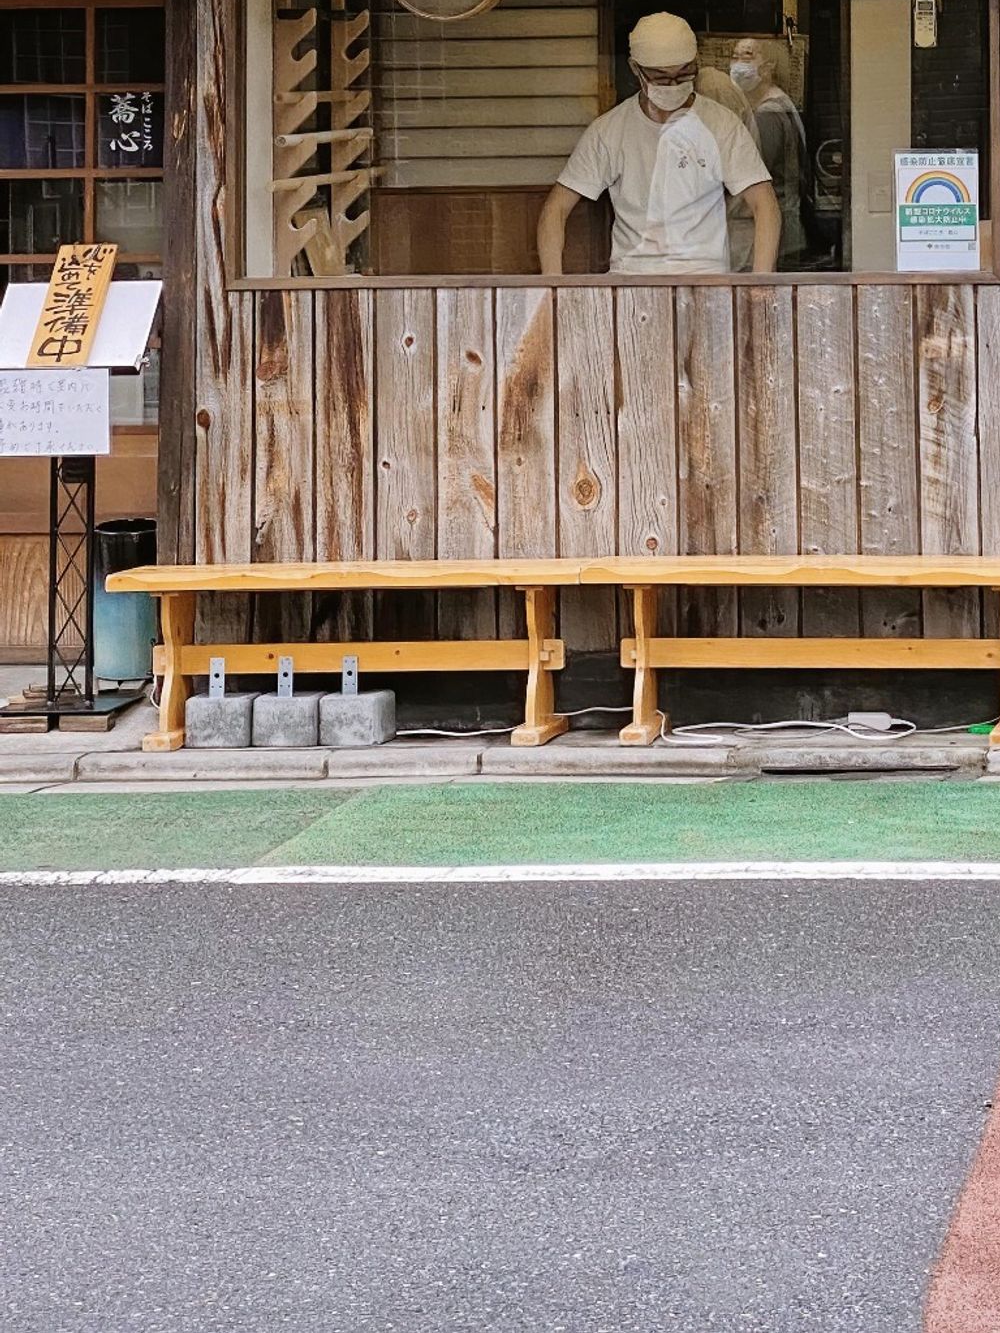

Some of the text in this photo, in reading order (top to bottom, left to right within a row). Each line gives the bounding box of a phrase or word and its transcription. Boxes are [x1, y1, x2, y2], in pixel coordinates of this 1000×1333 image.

[108, 92, 141, 152] 蕎心
[140, 91, 154, 151] そばこころ
